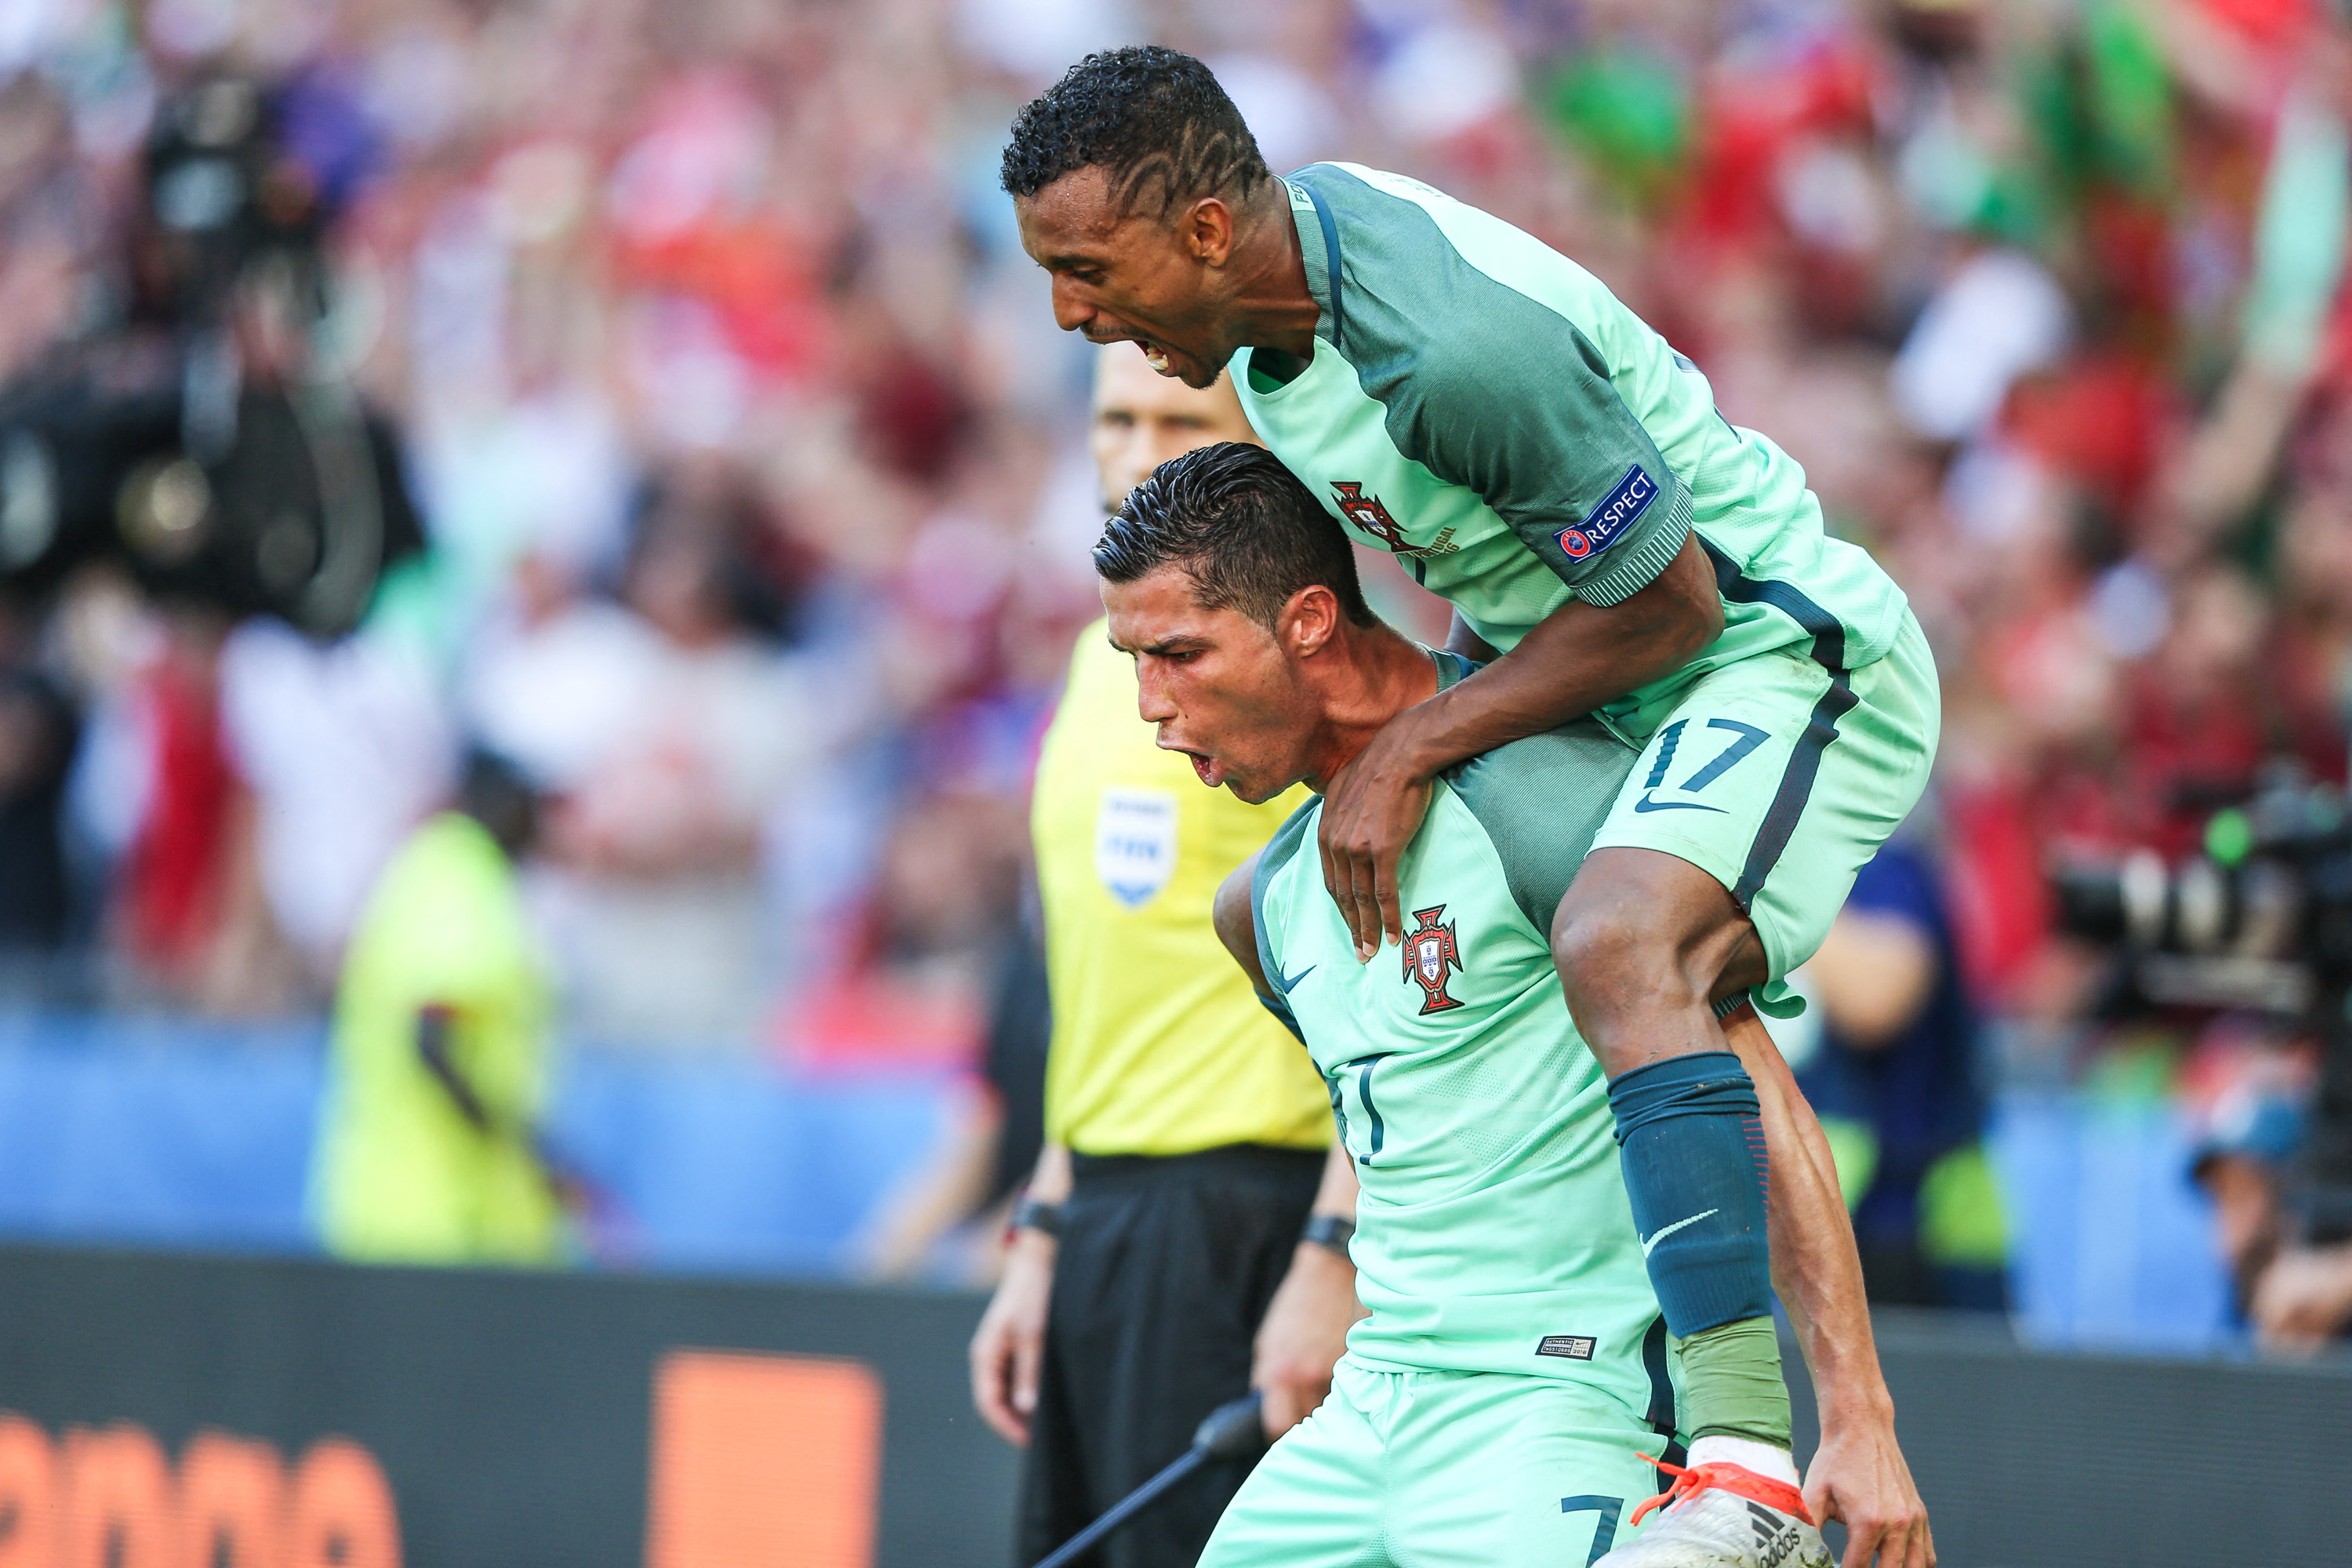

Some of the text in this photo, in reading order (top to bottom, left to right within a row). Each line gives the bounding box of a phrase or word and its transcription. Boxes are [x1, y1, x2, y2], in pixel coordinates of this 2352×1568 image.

[1563, 532, 1577, 541] UEFA
[1584, 471, 1651, 544] RESPECT
[1643, 717, 1772, 793] 17
[1561, 1494, 1624, 1568] 7
[1760, 1527, 1801, 1568] adidas
